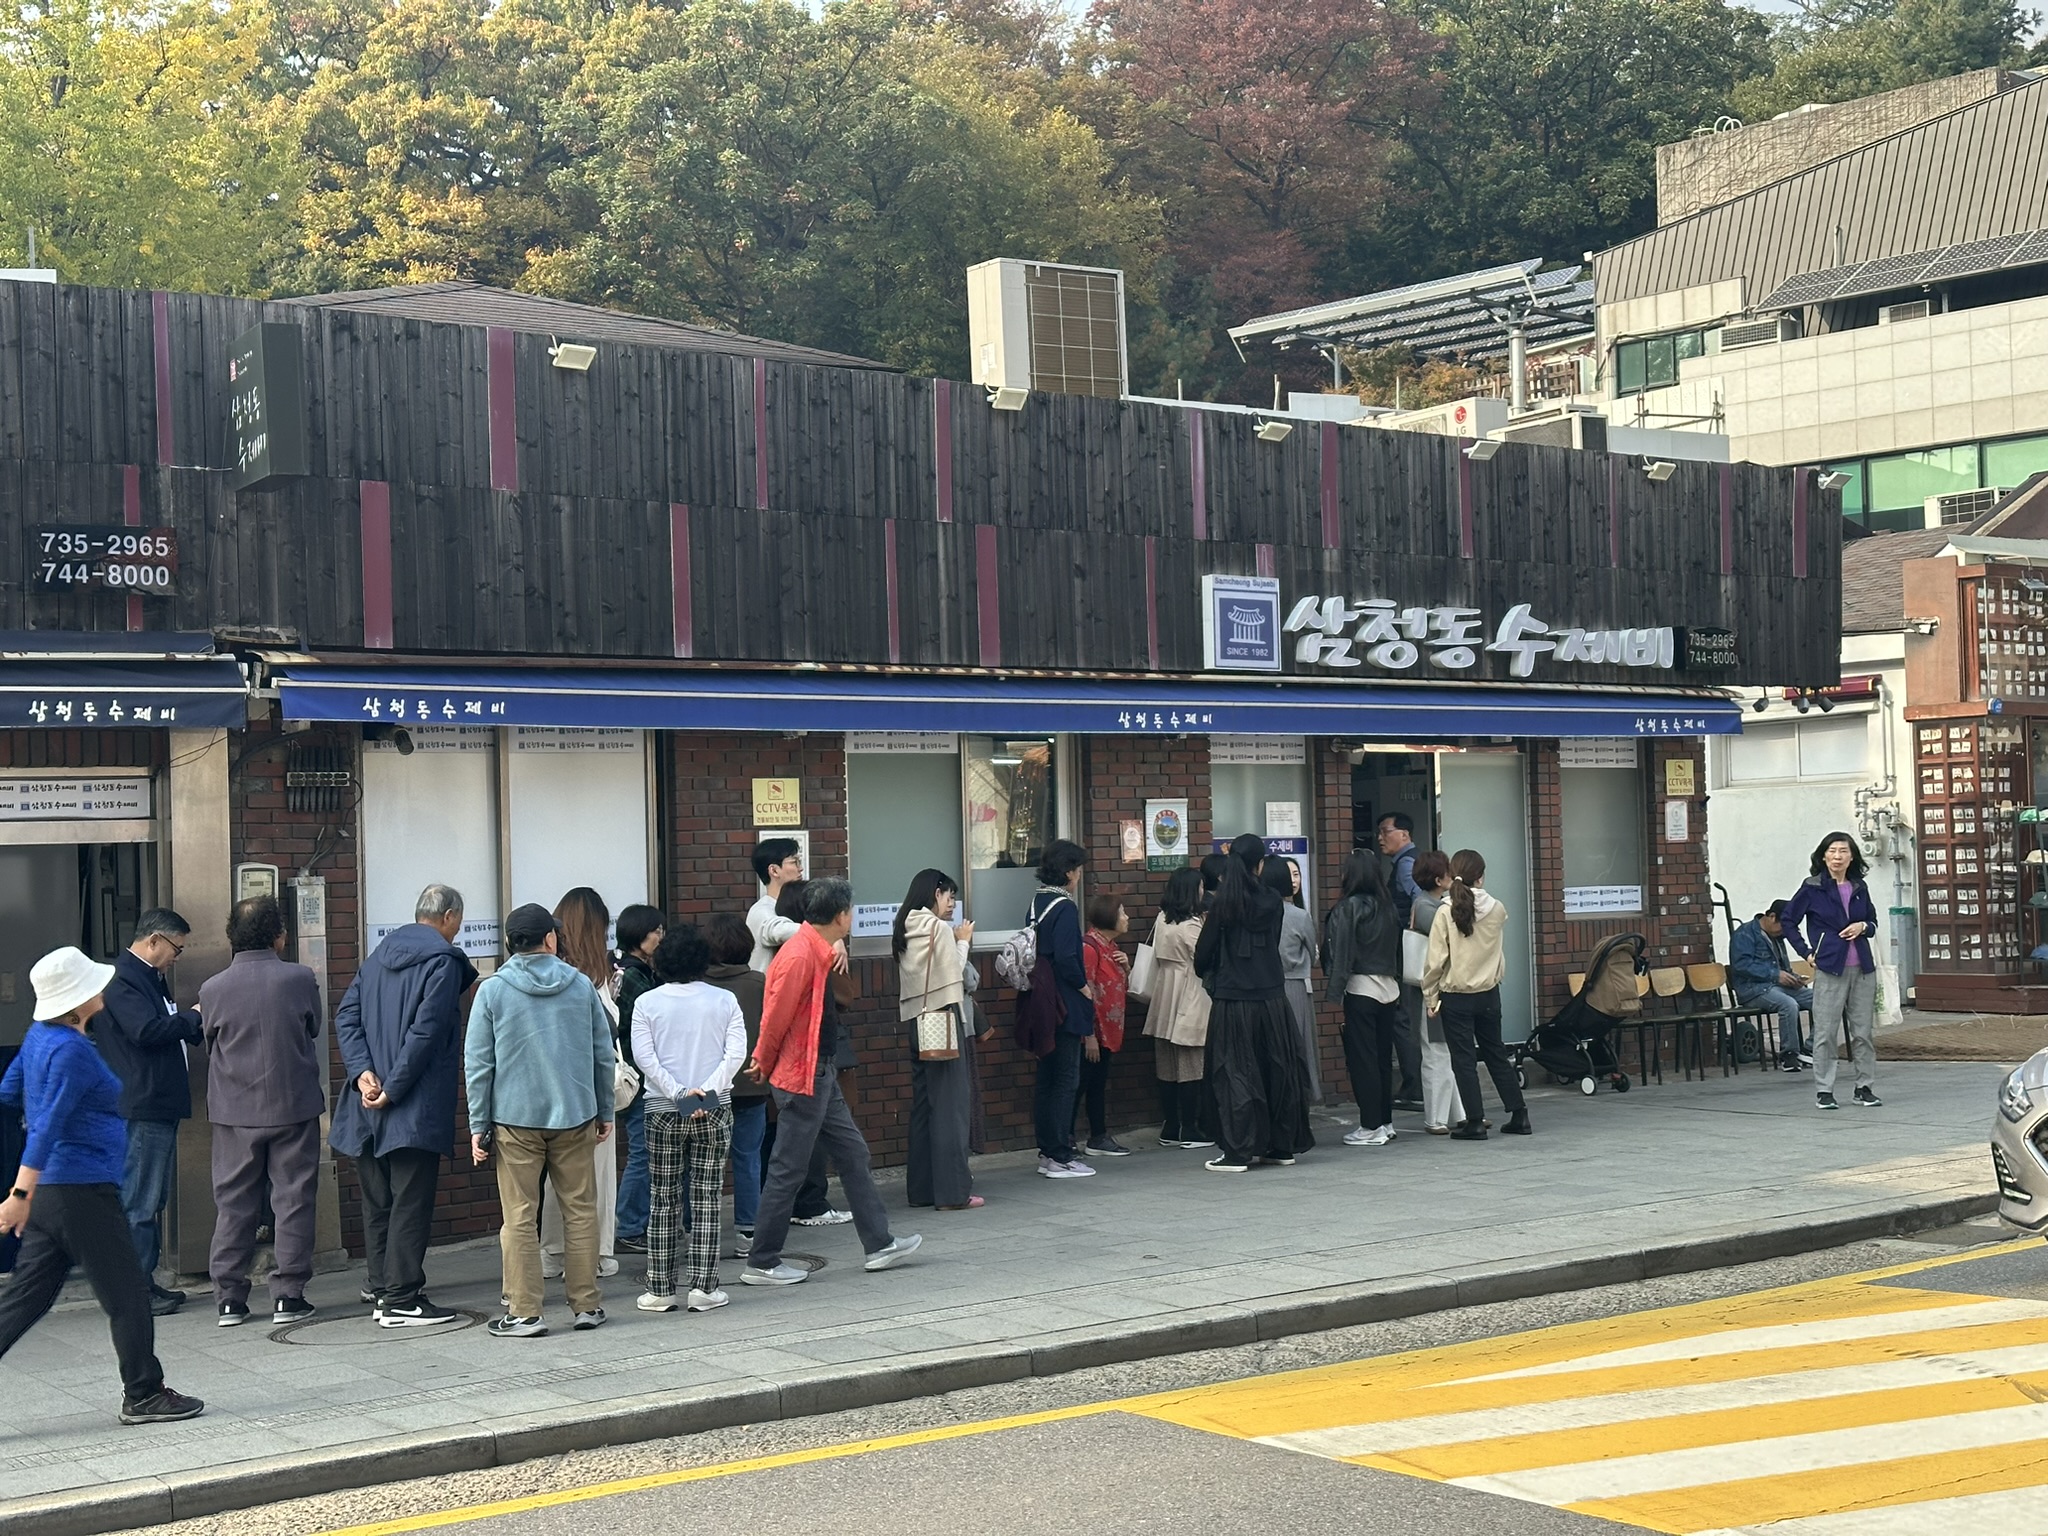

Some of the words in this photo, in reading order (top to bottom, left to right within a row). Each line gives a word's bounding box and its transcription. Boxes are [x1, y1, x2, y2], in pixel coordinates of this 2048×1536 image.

[231, 386, 261, 431] 삼청동
[238, 432, 267, 473] 수제비
[40, 532, 169, 557] 735-2965
[41, 562, 170, 586] 744-8000
[1214, 577, 1251, 588] Samcheong
[1689, 633, 1735, 647] 735-2965
[1226, 646, 1249, 656] SINCE
[1251, 648, 1269, 657] 1982
[1689, 650, 1735, 664] 744-8000
[756, 802, 798, 815] CCTV목적
[1269, 840, 1294, 853] 수제비
